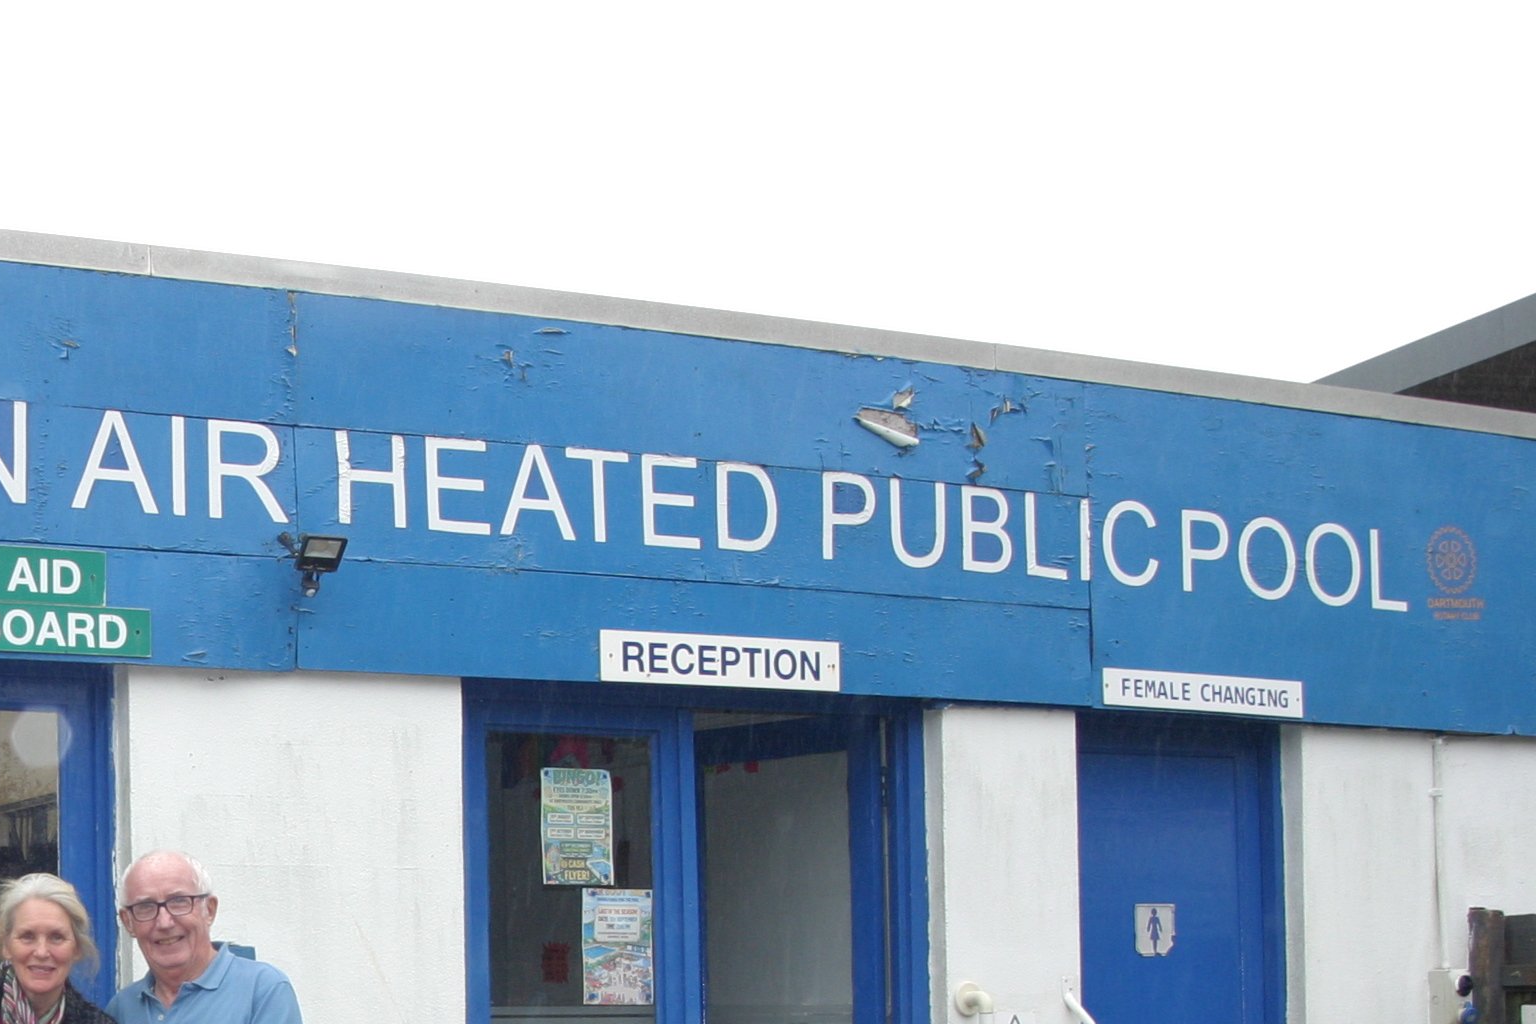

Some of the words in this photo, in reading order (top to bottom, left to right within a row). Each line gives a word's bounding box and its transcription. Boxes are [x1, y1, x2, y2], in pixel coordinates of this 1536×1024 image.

[71, 410, 290, 524] AIR
[334, 429, 778, 553] HEATED
[821, 470, 1160, 588] PUBLIC
[1180, 509, 1408, 613] POOL
[7, 557, 82, 595] AID
[621, 641, 821, 682] RECEPTION
[1121, 678, 1191, 701] FEMALE
[1200, 683, 1289, 708] CHANGING
[564, 870, 590, 881] FLYER!
[568, 859, 585, 868] CASH
